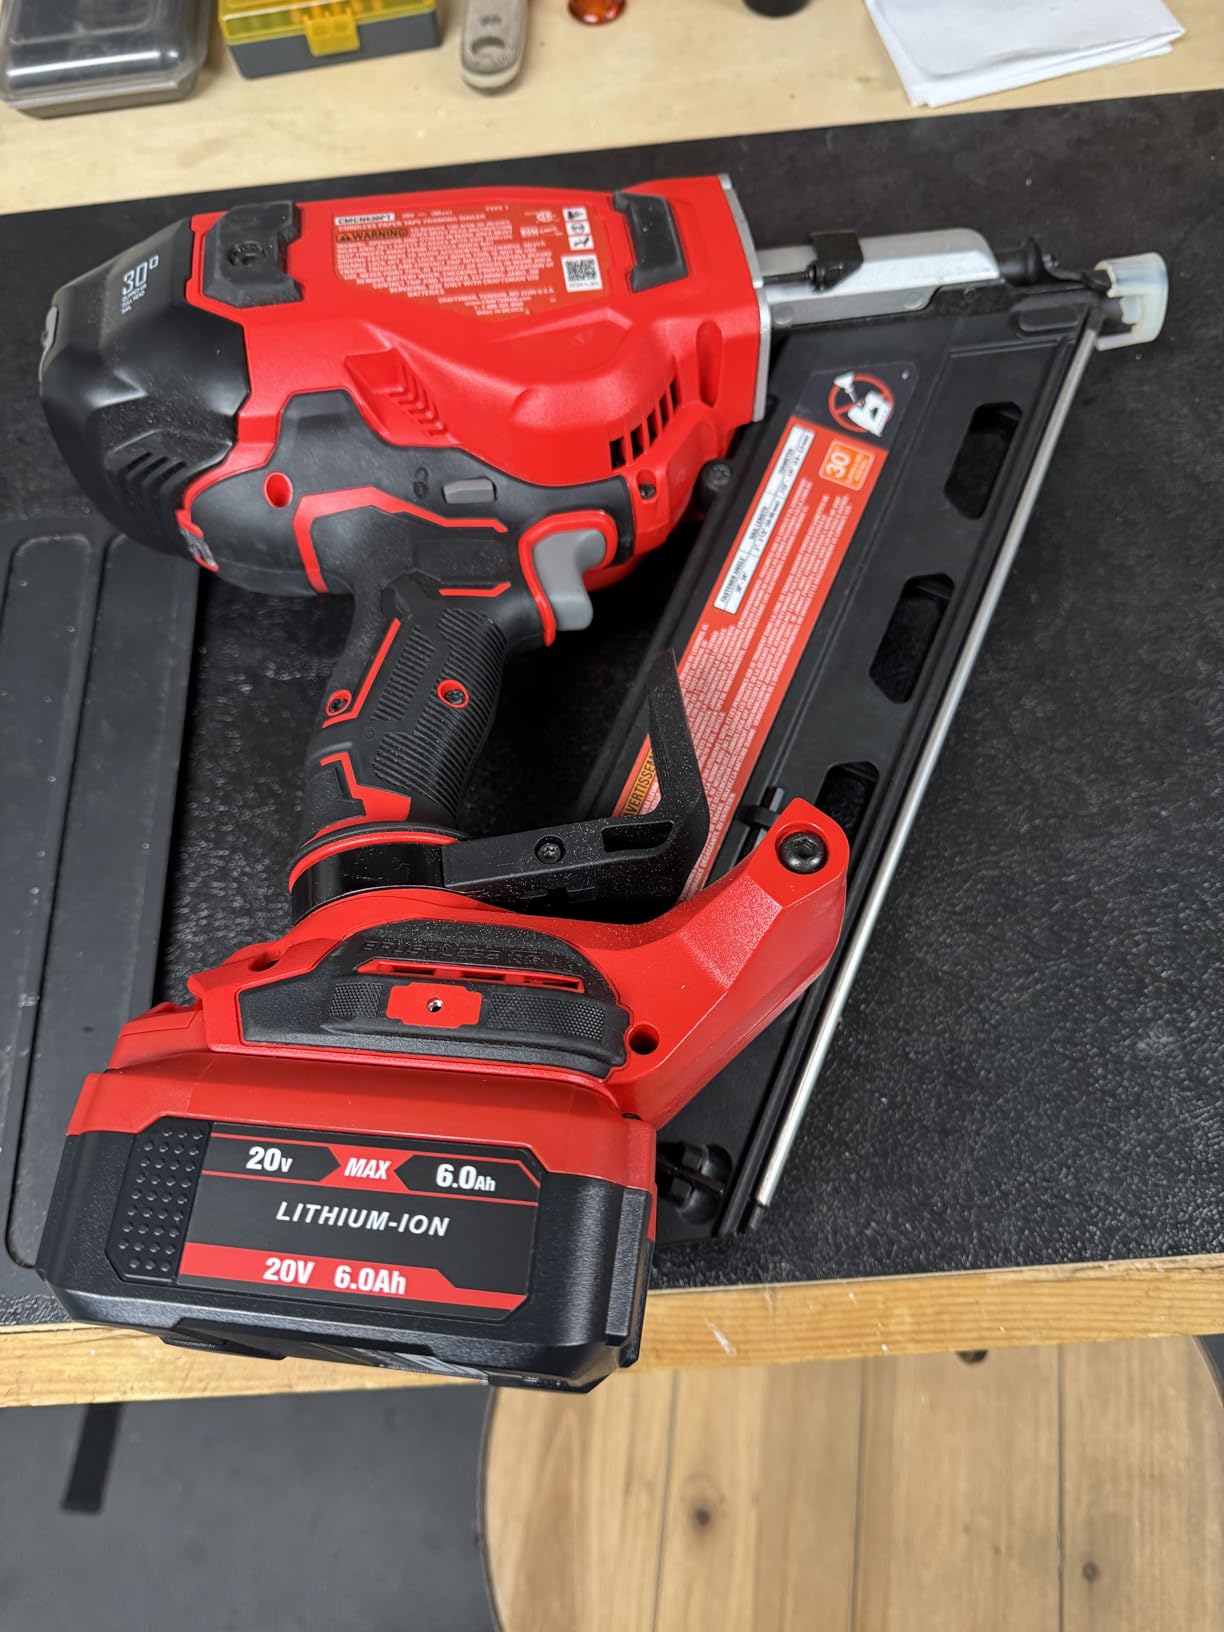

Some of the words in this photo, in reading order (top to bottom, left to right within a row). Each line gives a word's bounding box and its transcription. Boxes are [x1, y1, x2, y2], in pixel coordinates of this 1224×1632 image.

[352, 229, 405, 241] WARNING
[719, 574, 736, 602] FASTENER
[732, 556, 744, 575] ANGLE
[344, 1157, 392, 1180] MAX
[436, 1163, 496, 1192] 6.0Ah
[276, 1201, 450, 1236] LITHIUM-ION
[263, 1257, 314, 1285] 20V
[334, 1264, 406, 1294] 6.0Ah
